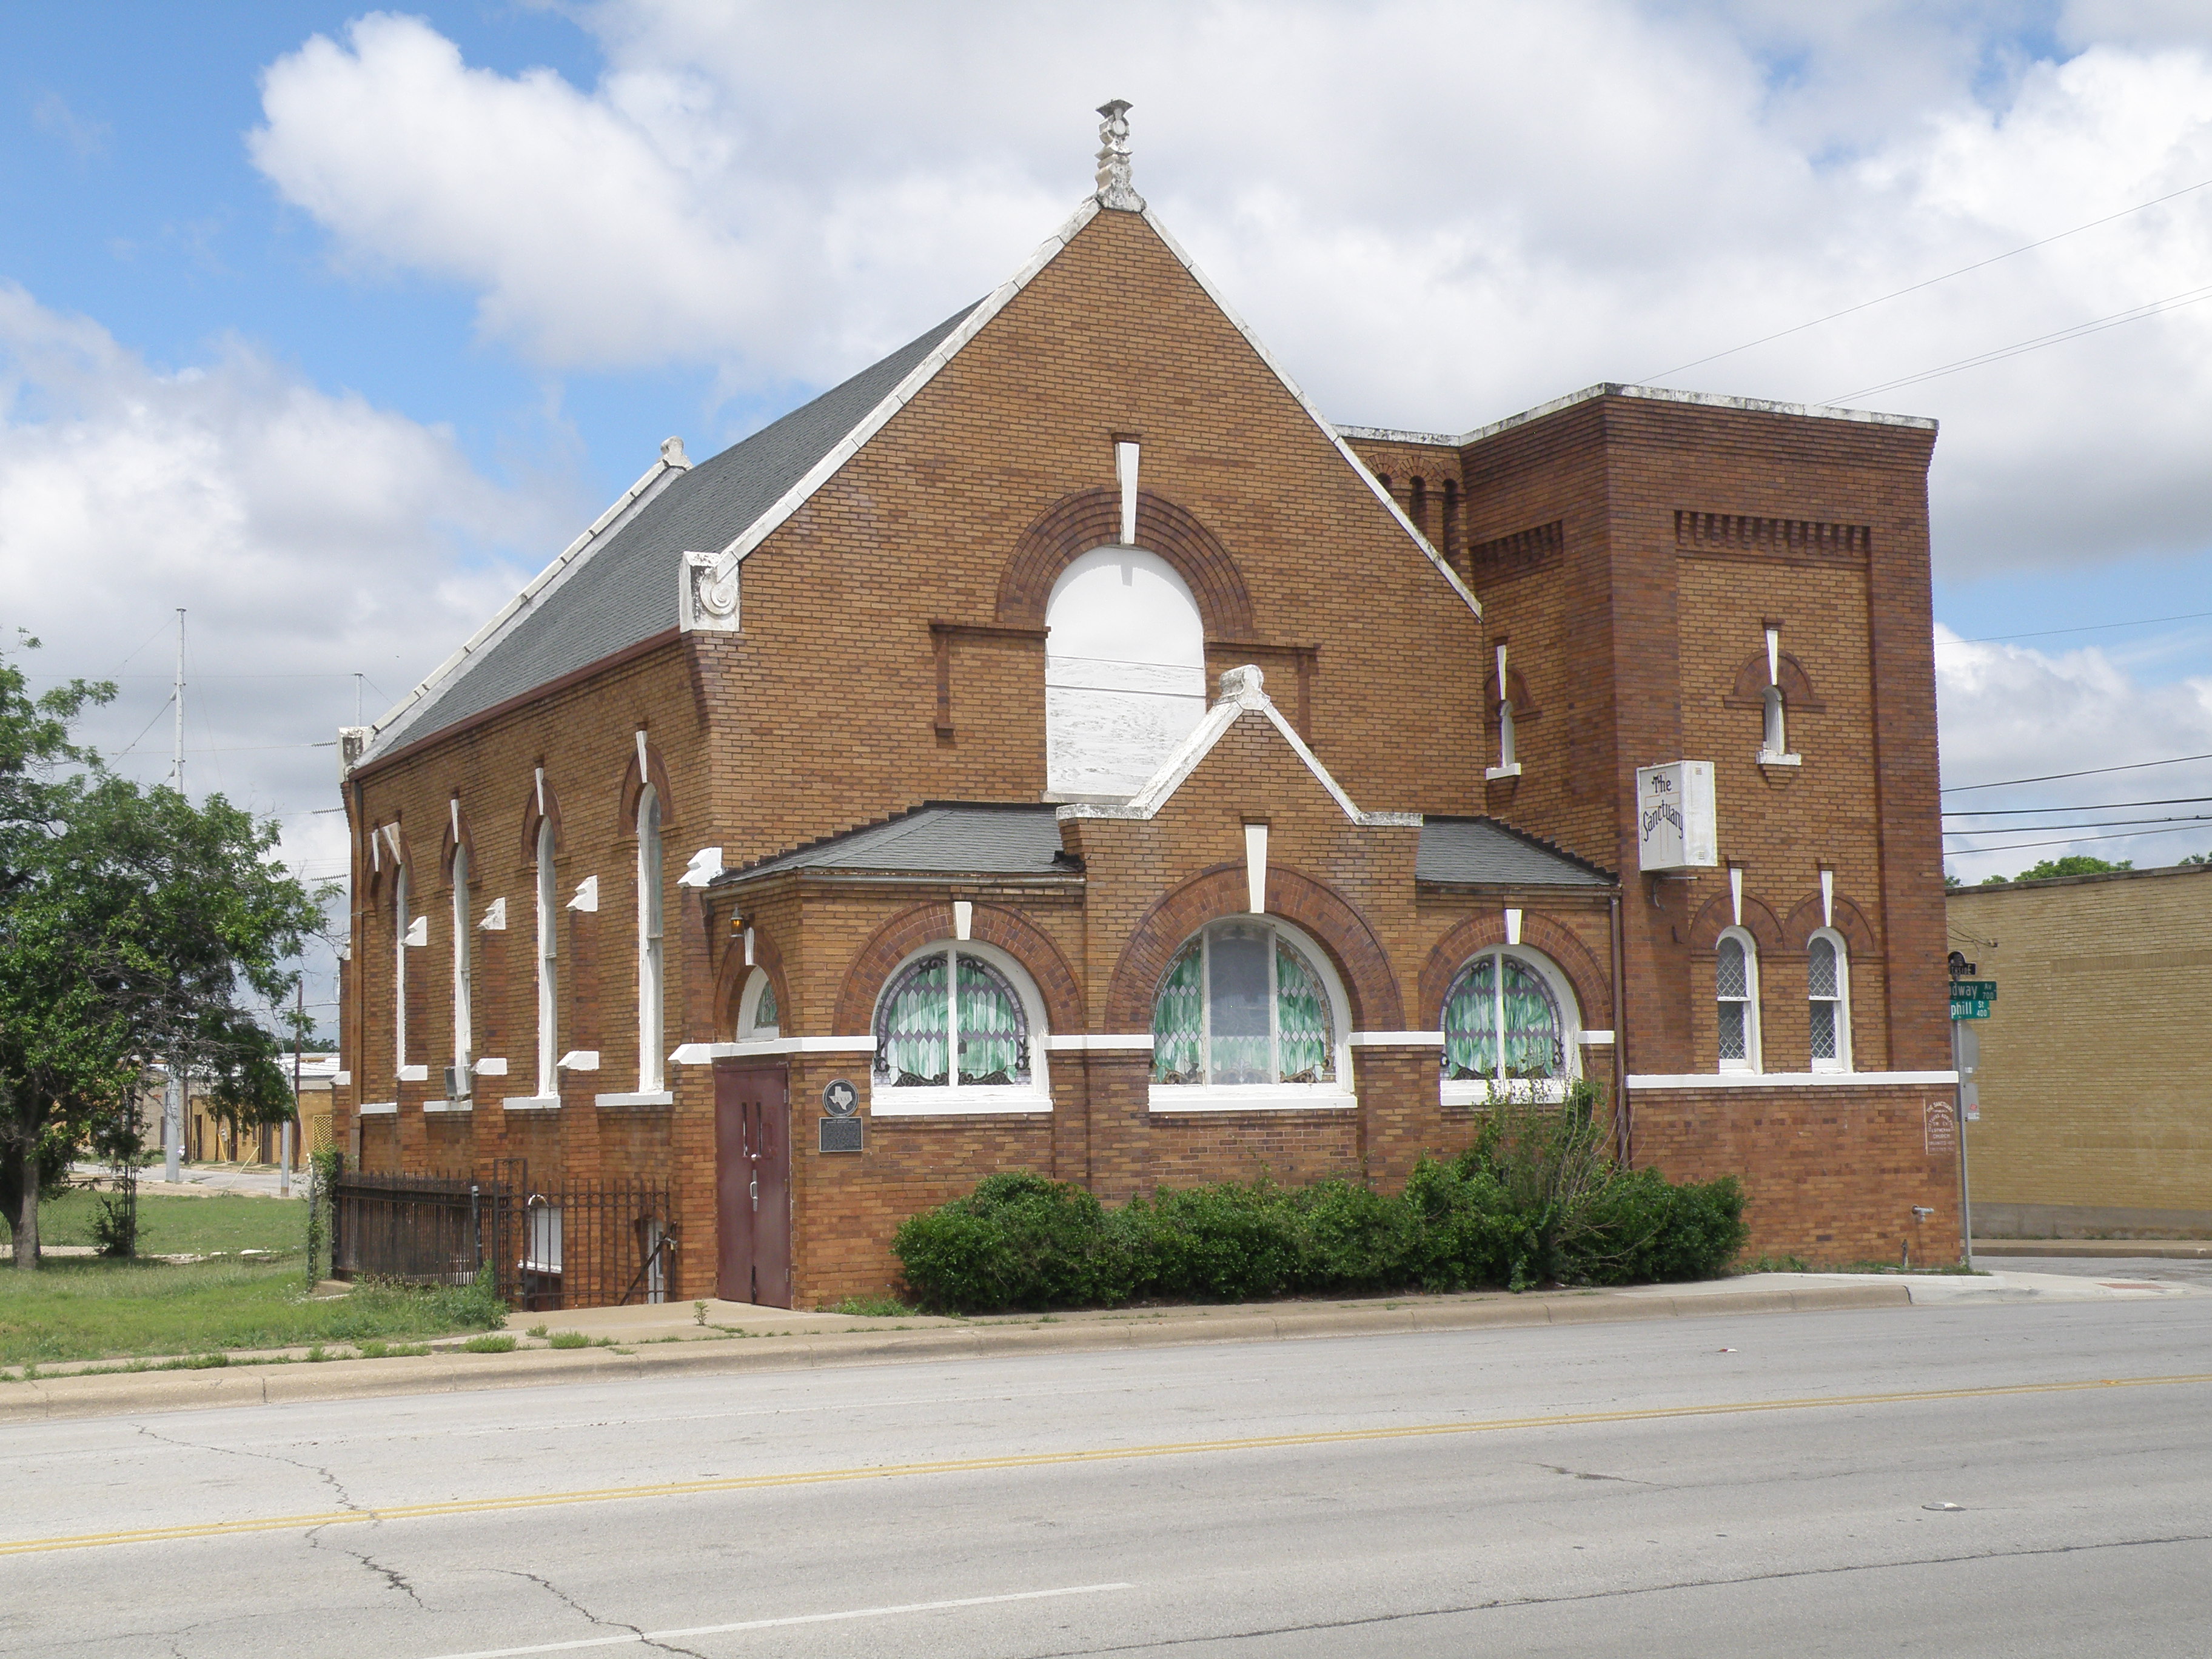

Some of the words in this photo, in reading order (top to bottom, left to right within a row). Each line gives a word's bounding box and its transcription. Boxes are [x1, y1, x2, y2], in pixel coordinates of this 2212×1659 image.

[1651, 774, 1672, 793] The
[1643, 799, 1683, 842] Sanctuary
[1951, 1000, 1972, 1019] phill
[1932, 1101, 1954, 1113] SANCTUARY
